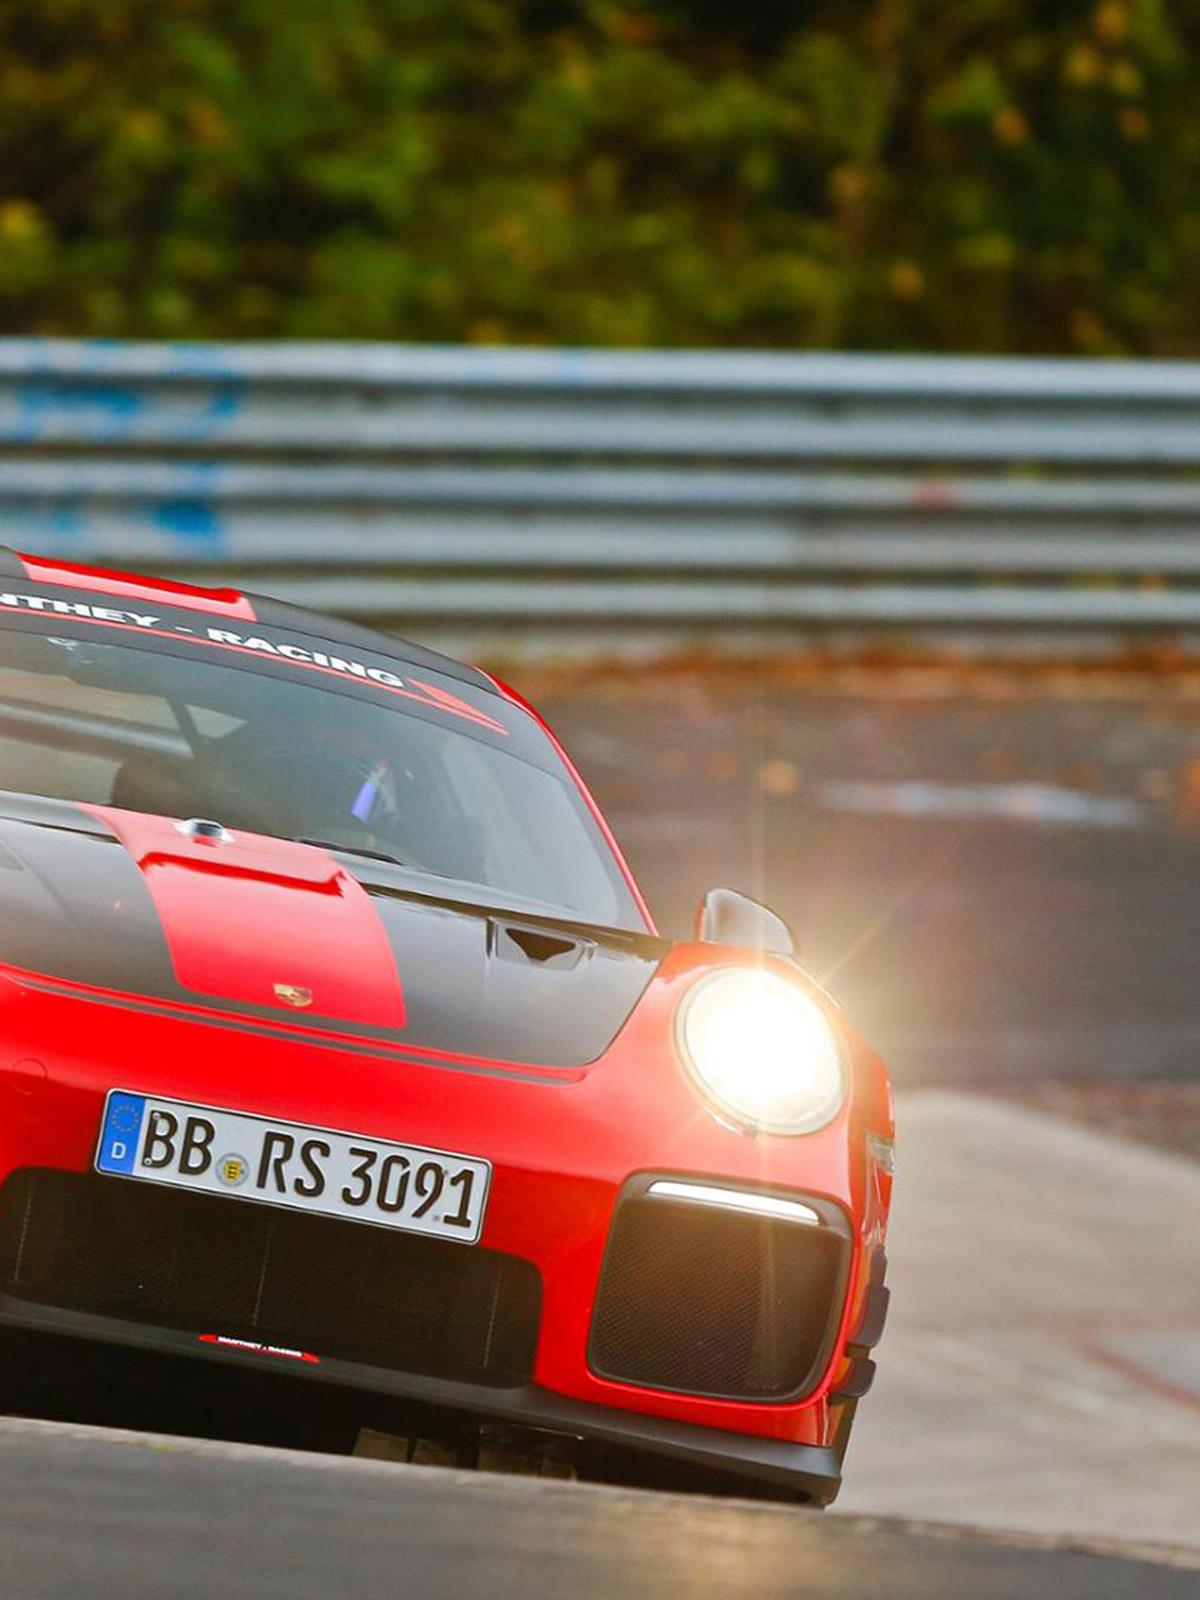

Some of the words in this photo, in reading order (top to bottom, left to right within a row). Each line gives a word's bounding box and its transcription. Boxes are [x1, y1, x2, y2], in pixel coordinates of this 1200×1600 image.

[207, 628, 404, 687] RACING
[111, 1142, 126, 1159] D
[142, 1110, 215, 1175] BB
[257, 1130, 330, 1197] RS
[342, 1147, 474, 1228] 3091
